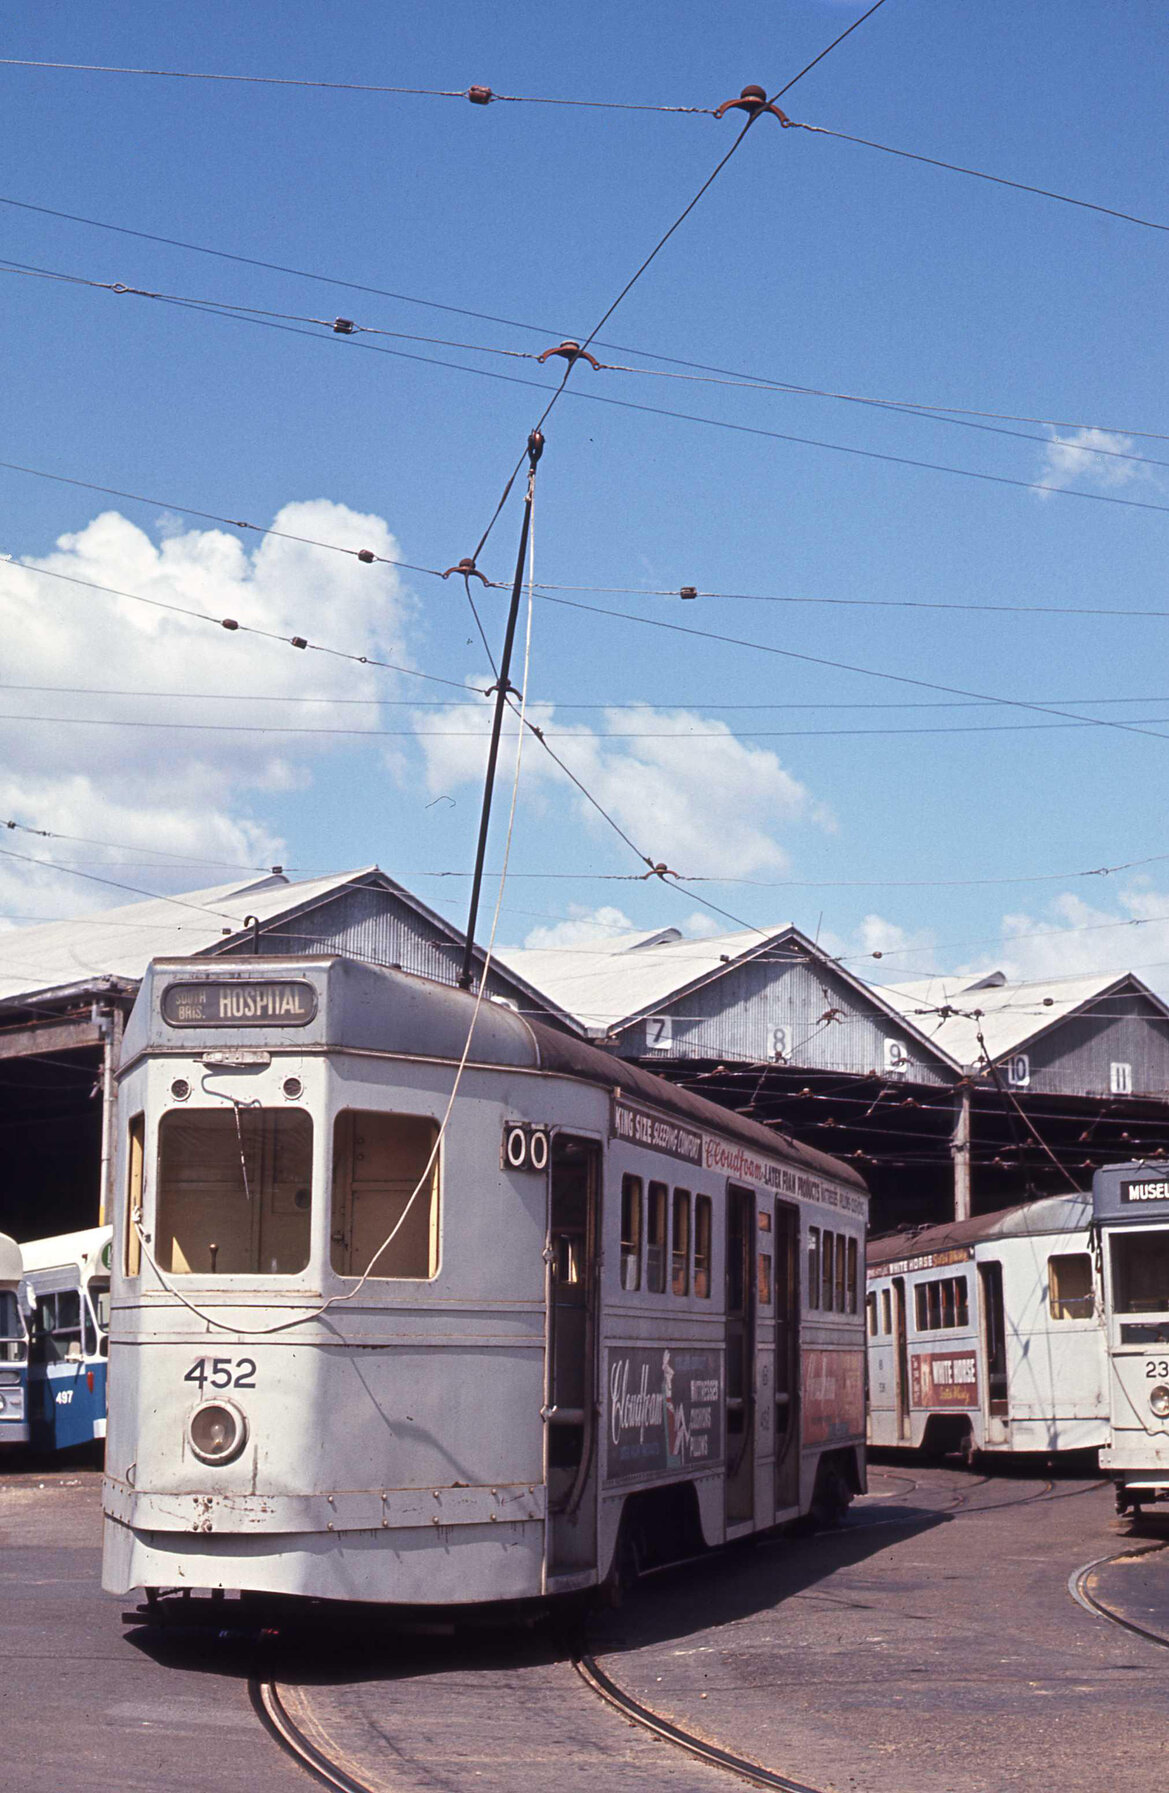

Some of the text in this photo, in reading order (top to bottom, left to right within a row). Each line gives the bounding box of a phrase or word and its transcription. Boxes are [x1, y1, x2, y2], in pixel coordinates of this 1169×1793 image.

[176, 991, 206, 1004] SOUTH
[219, 988, 305, 1018] HOSPITAL
[652, 1018, 665, 1043] 7
[773, 1028, 786, 1054] 8
[889, 1043, 902, 1065] 9
[1008, 1056, 1027, 1082] 10
[1116, 1066, 1127, 1090] 11
[615, 1106, 701, 1159] KING SIZE SLEEPING COMFORT
[706, 1138, 763, 1179] Cloudfoam
[764, 1163, 781, 1191] LATEX
[782, 1169, 796, 1195] FOAM
[797, 1175, 820, 1202] PRODUCTS
[889, 1260, 908, 1274] WHITE
[909, 1255, 933, 1271] HORSE
[184, 1357, 257, 1389] 452
[953, 1358, 976, 1384] HORSE
[1146, 1361, 1169, 1378] 23
[56, 1390, 74, 1405] 497
